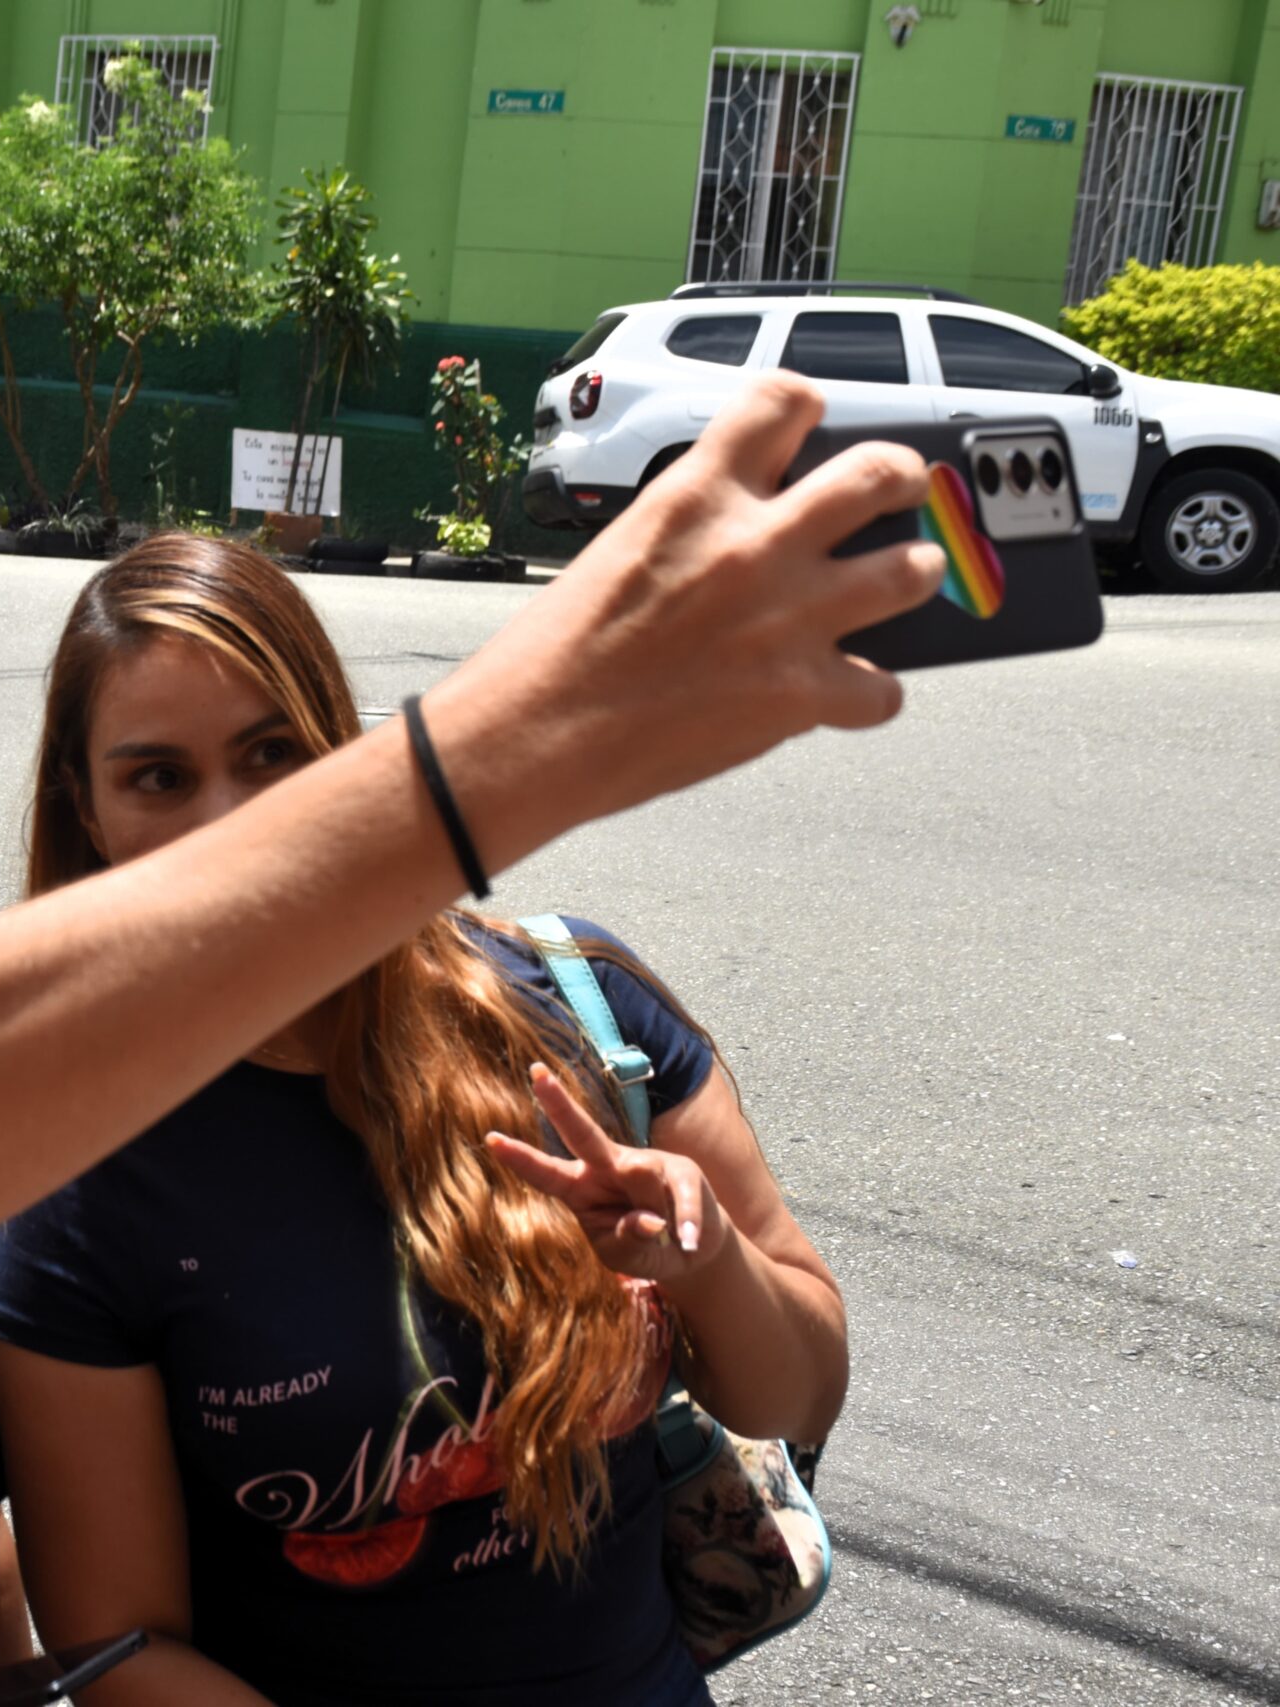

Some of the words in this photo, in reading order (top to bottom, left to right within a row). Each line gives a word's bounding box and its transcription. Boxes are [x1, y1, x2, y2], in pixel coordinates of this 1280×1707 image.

[1094, 406, 1133, 427] 1066
[179, 1257, 199, 1272] TO
[198, 1386, 227, 1407] I'M
[232, 1364, 333, 1408] ALREADY
[202, 1411, 239, 1436] THE
